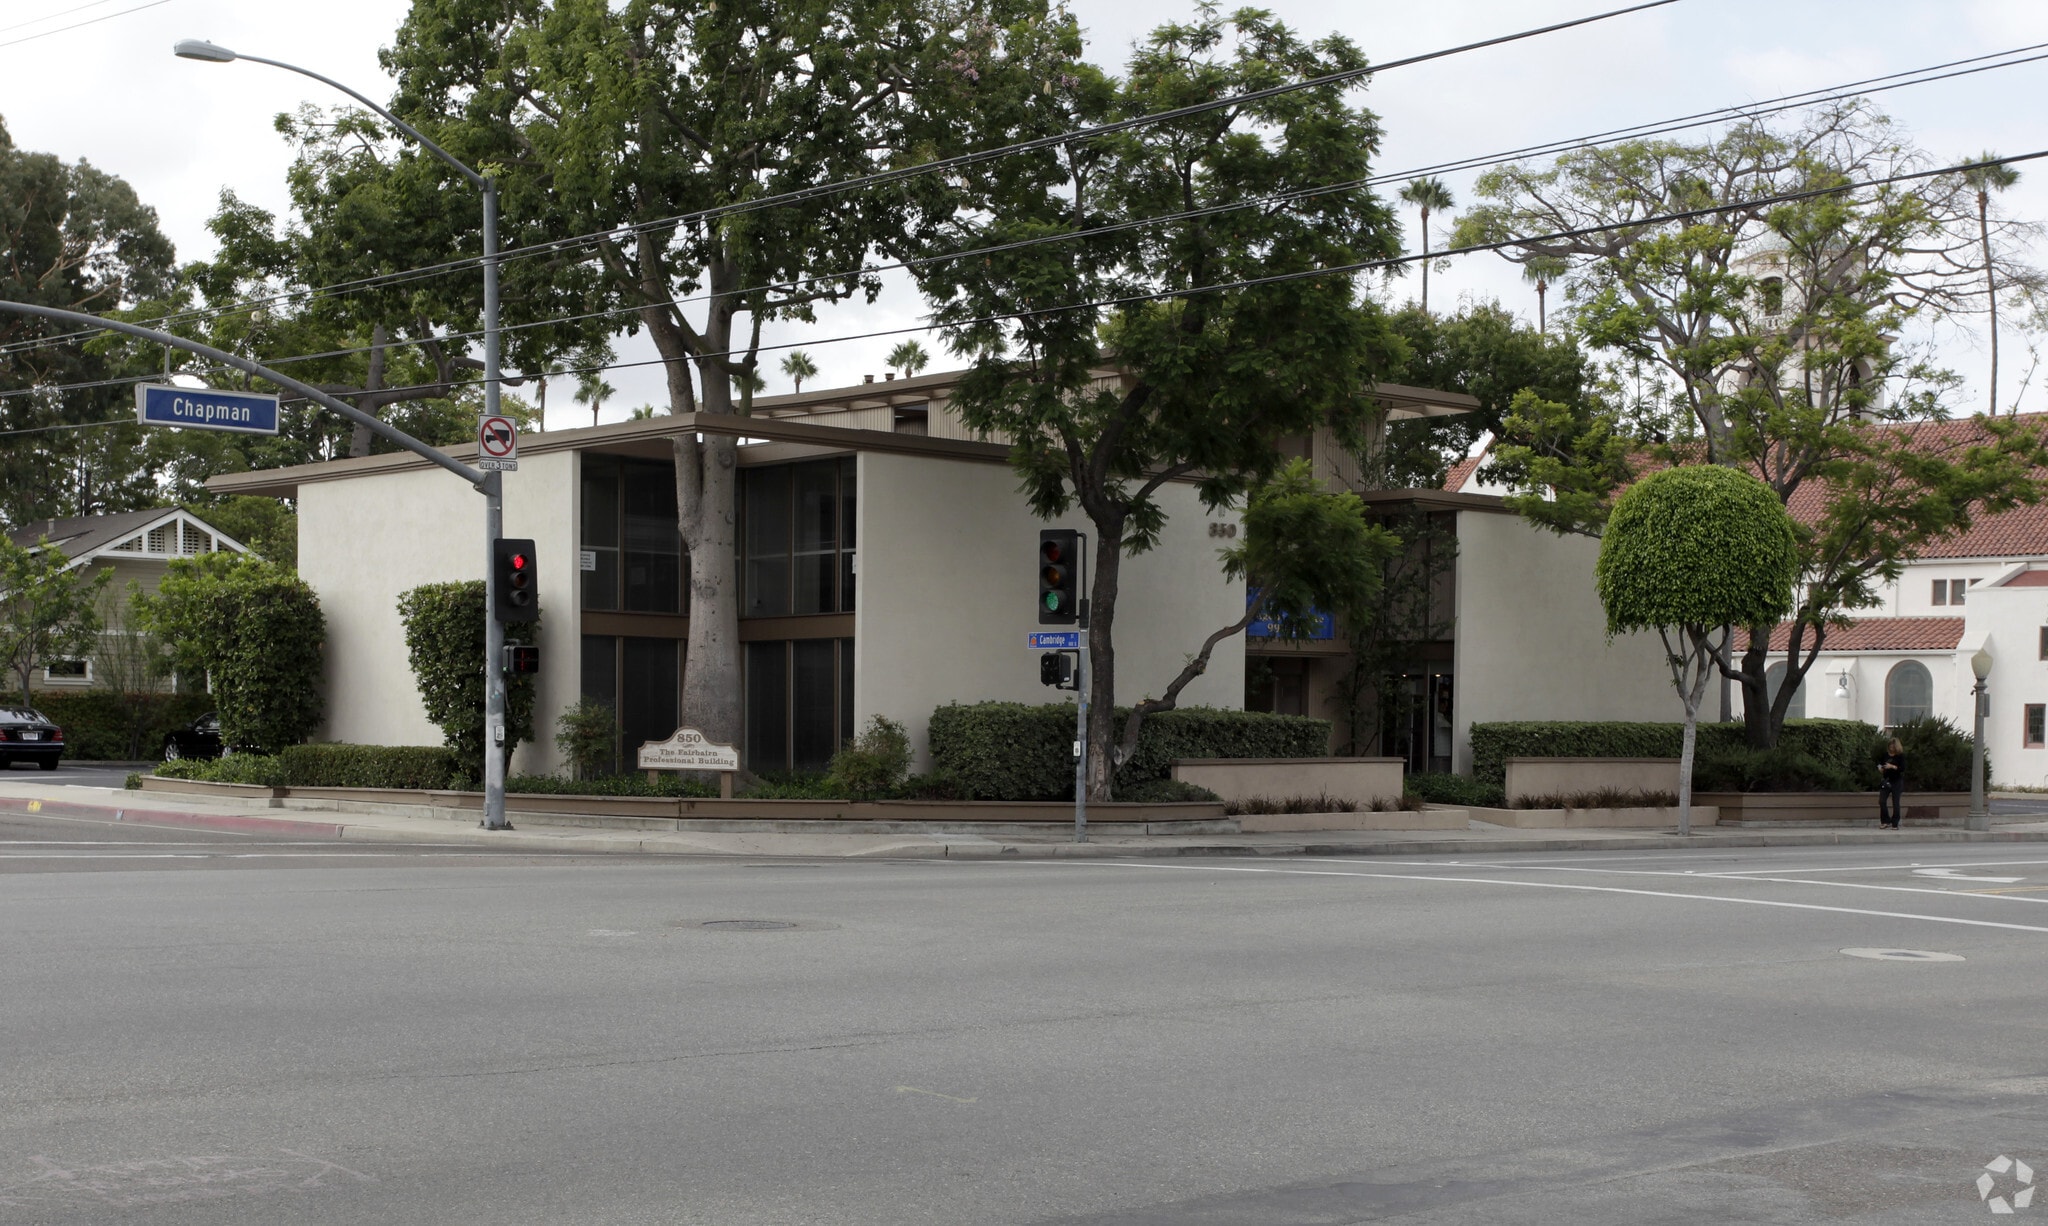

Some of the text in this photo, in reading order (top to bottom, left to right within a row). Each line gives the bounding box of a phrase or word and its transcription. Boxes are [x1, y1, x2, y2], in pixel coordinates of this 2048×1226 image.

[173, 397, 250, 422] Chapman
[1040, 634, 1065, 646] Cambridge
[677, 733, 701, 743] 850
[660, 748, 718, 757] The Fairbairn
[643, 756, 735, 767] Professional Building
